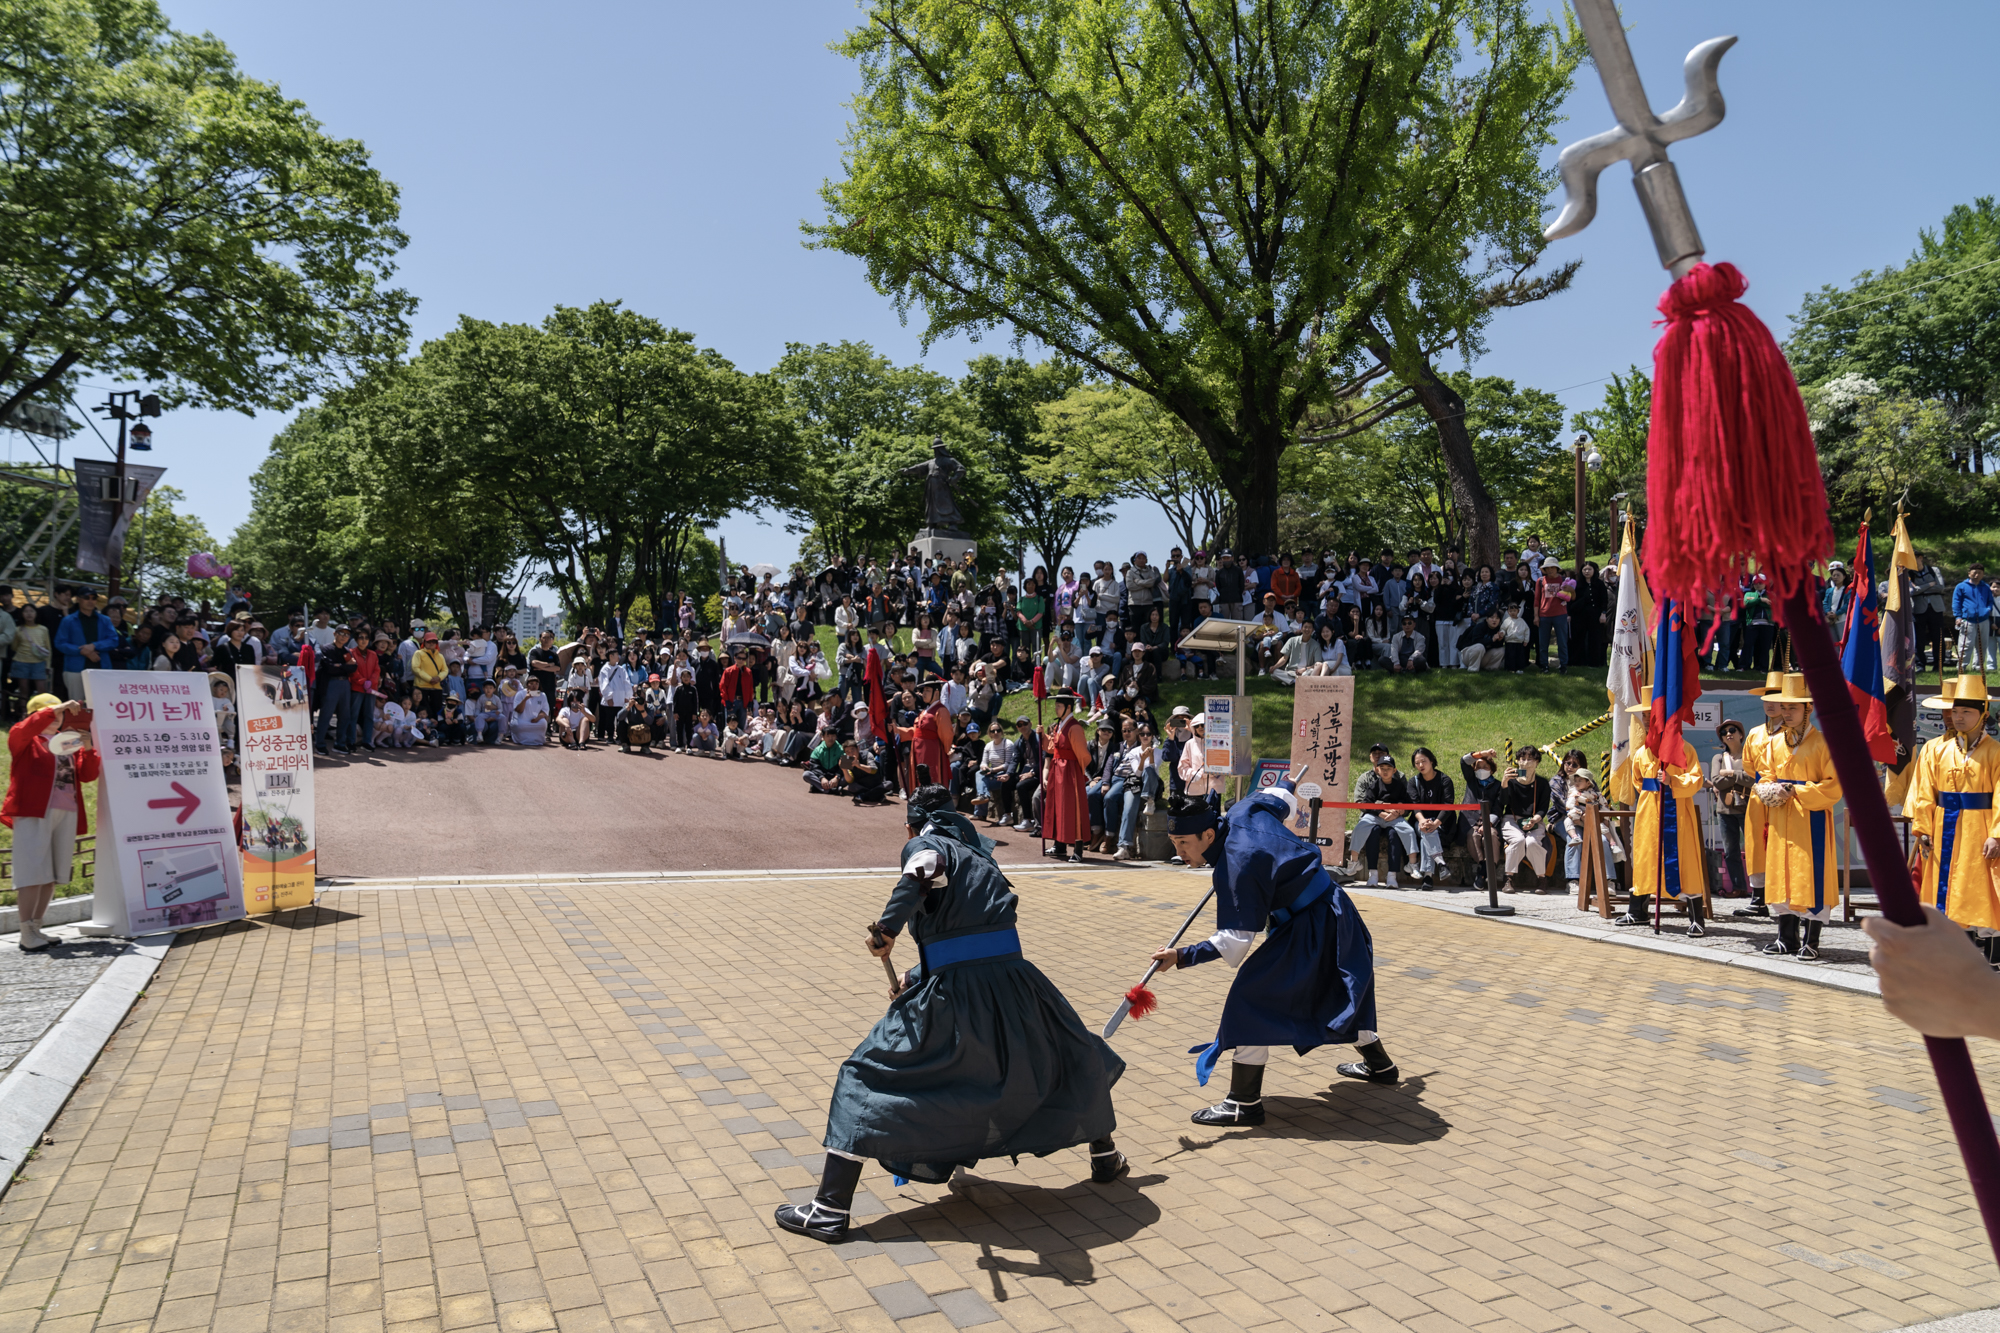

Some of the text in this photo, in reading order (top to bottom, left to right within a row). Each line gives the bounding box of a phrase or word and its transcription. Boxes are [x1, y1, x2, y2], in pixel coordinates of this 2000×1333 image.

[118, 683, 191, 695] 실경역사뮤지컬
[1694, 711, 1712, 721] 치도
[252, 717, 278, 731] 진주성
[112, 734, 141, 743] 2025.
[245, 734, 308, 753] 수성중군영
[115, 746, 132, 755] 오후
[135, 745, 151, 755] 8시
[154, 744, 179, 754] 진주성
[181, 744, 197, 753] 의암
[269, 775, 291, 788] 11시
[271, 789, 286, 797] 진주성
